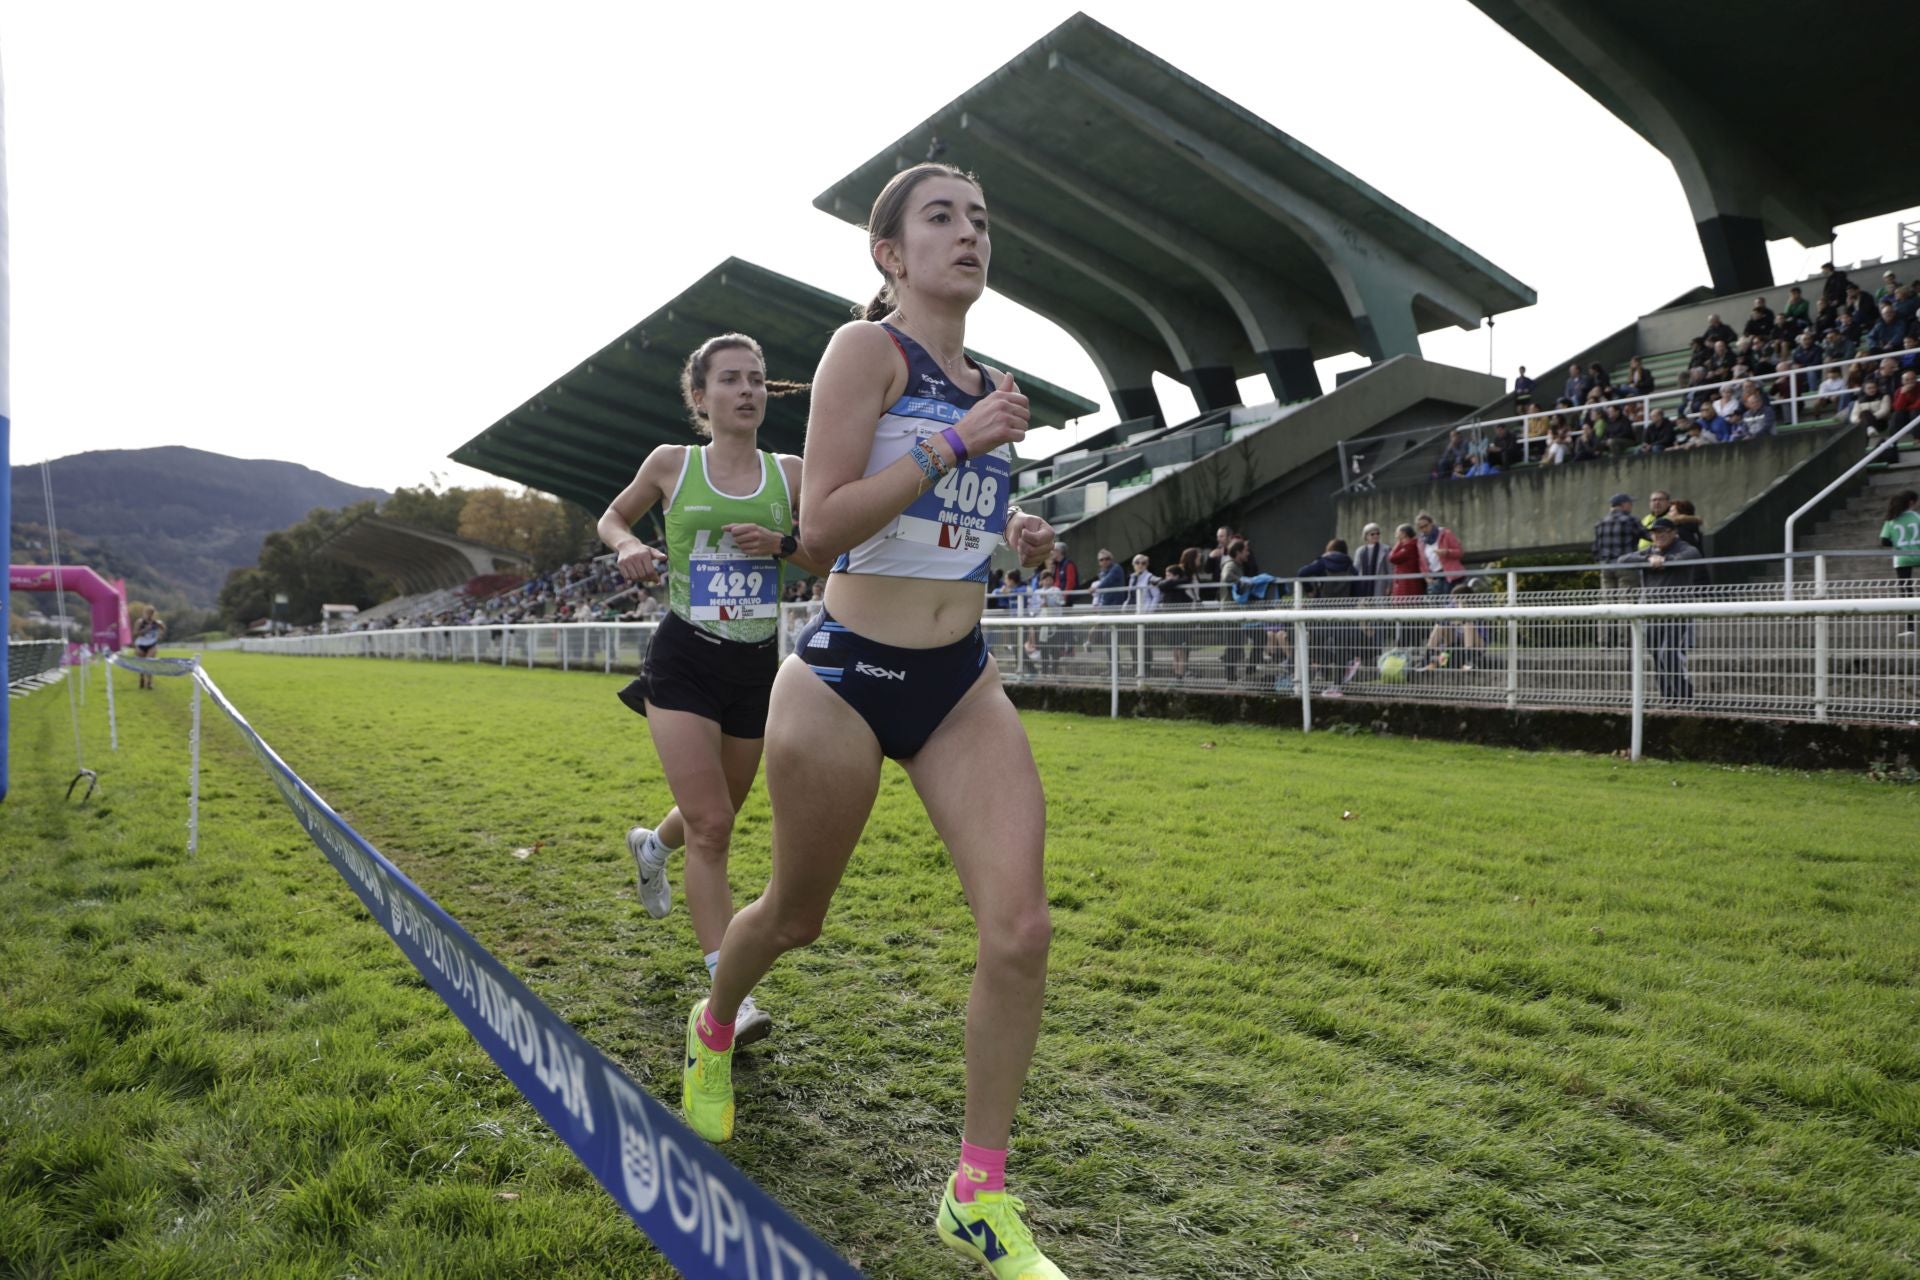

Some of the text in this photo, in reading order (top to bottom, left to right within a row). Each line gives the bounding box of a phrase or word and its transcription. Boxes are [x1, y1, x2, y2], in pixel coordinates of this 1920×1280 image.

[934, 467, 998, 517] 408
[938, 510, 986, 531] ANE LOPEZ
[964, 534, 981, 543] DIARIO
[964, 541, 980, 550] VASCO
[1893, 522, 1920, 547] 22
[696, 563, 707, 572] 69
[707, 571, 763, 597] 429
[738, 597, 761, 606] CALVO
[402, 894, 595, 1134] GIPUZKOA KIROLAK
[659, 1134, 829, 1280] GIPU
